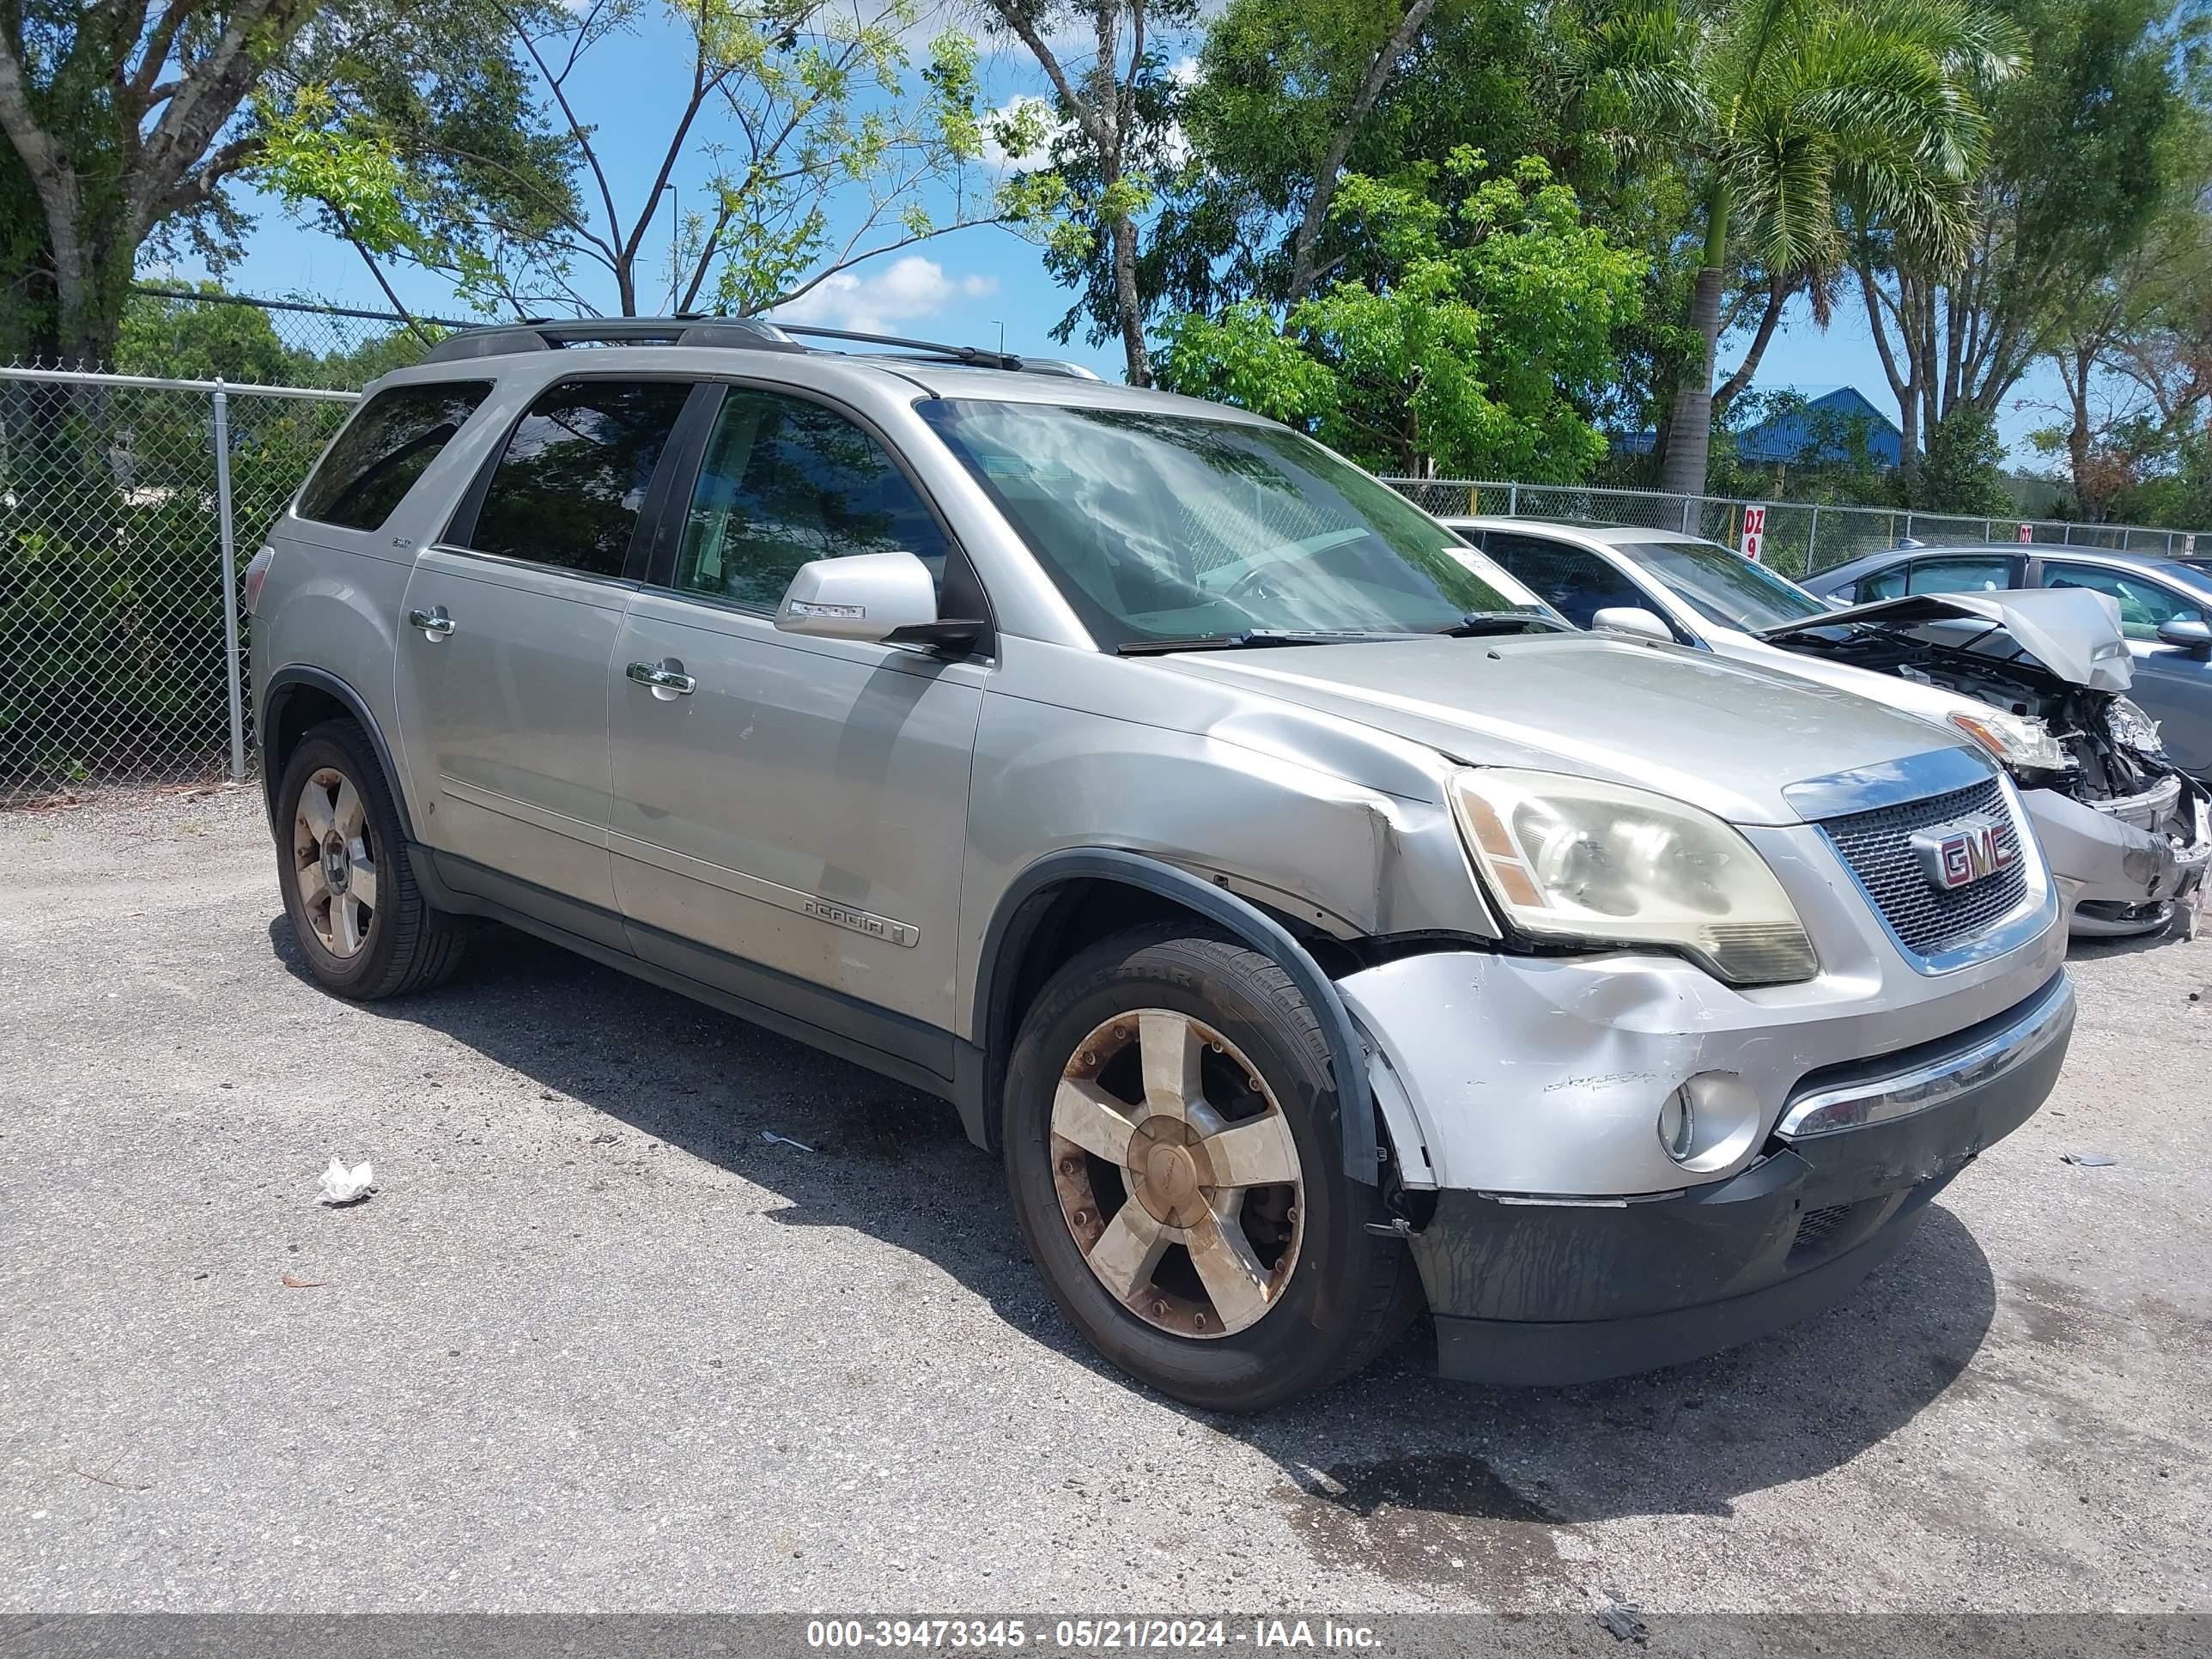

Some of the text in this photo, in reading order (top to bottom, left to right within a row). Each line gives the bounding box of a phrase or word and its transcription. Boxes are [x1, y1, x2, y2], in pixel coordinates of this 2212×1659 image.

[1745, 510, 1764, 534] DZ
[1747, 537, 1757, 559] 9
[1937, 824, 2014, 890] GMC
[803, 899, 884, 935] ACADIA
